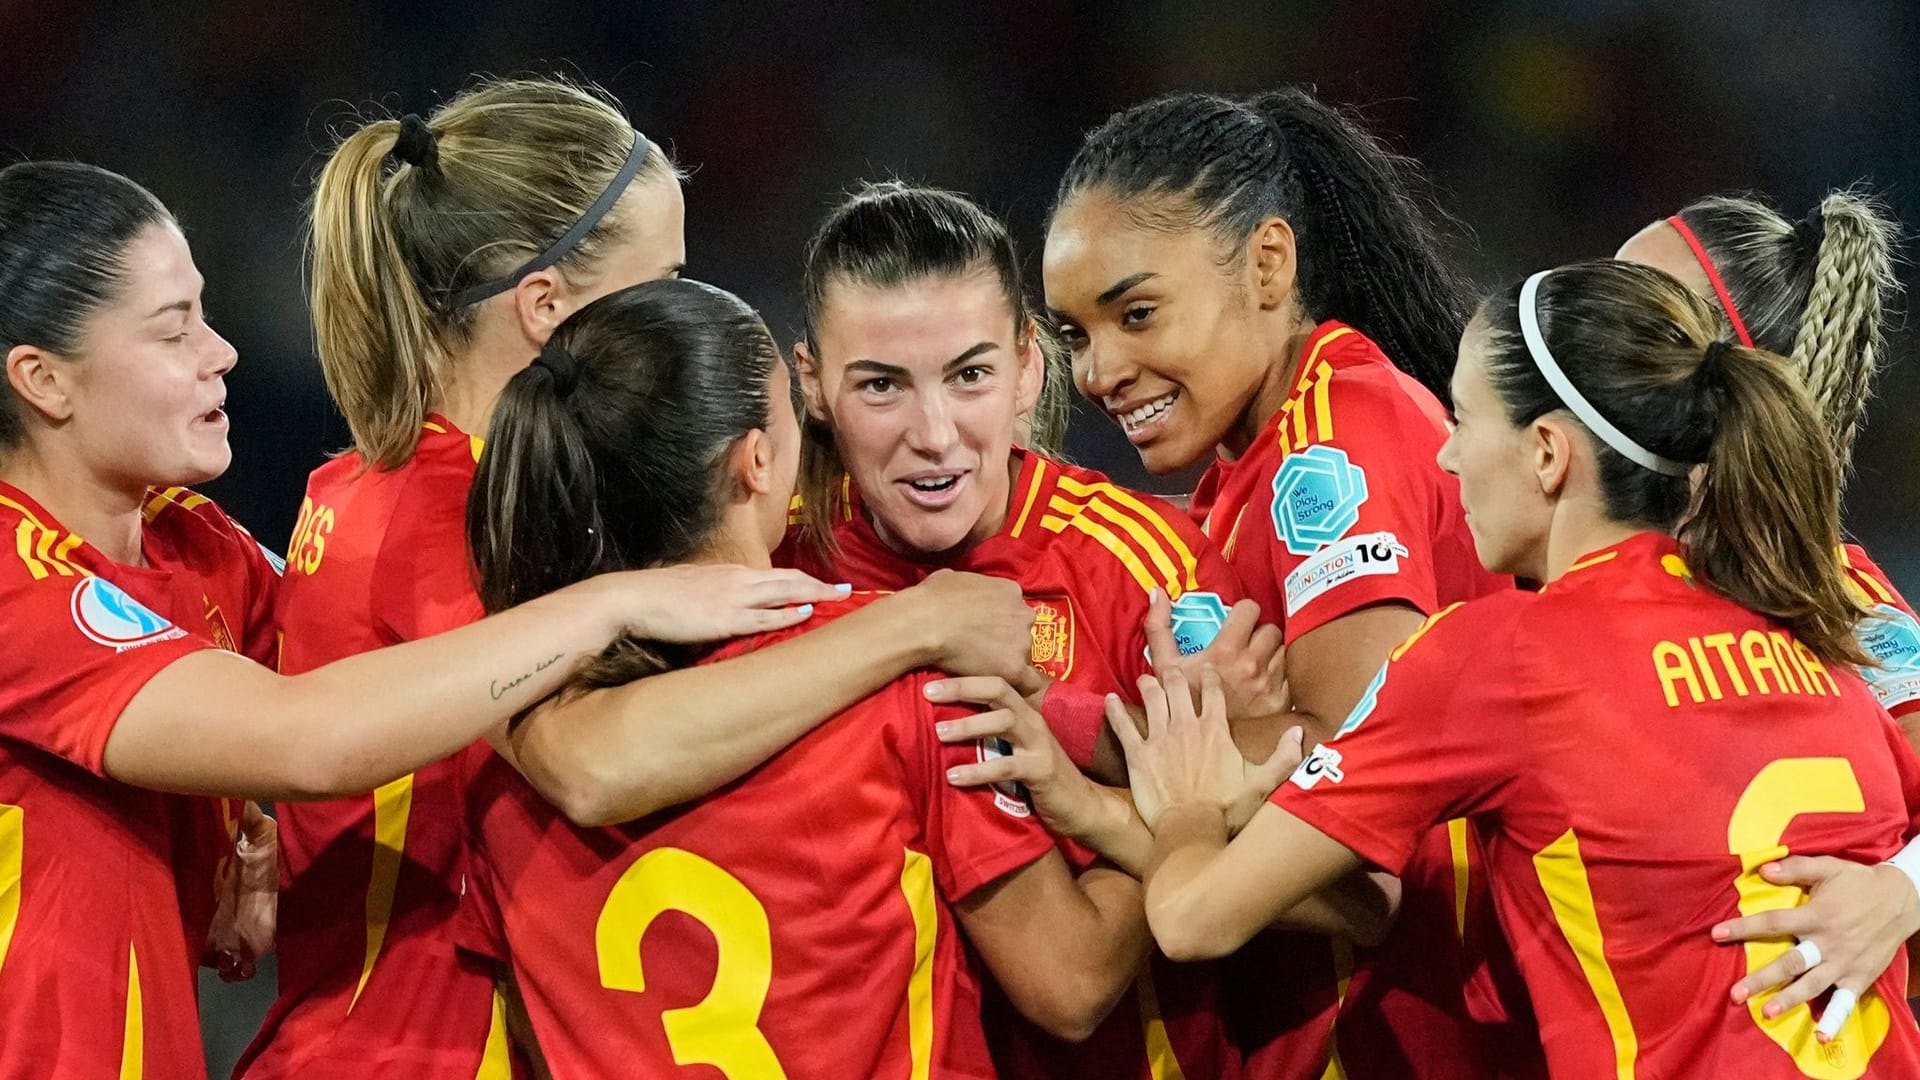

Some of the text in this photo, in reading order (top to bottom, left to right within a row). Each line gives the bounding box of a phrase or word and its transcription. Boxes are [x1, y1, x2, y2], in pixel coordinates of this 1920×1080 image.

[1292, 487, 1308, 498] We
[1356, 543, 1392, 563] 10
[1652, 629, 1841, 707] AITANA
[1727, 757, 1890, 1080] 6
[595, 846, 788, 1080] 3
